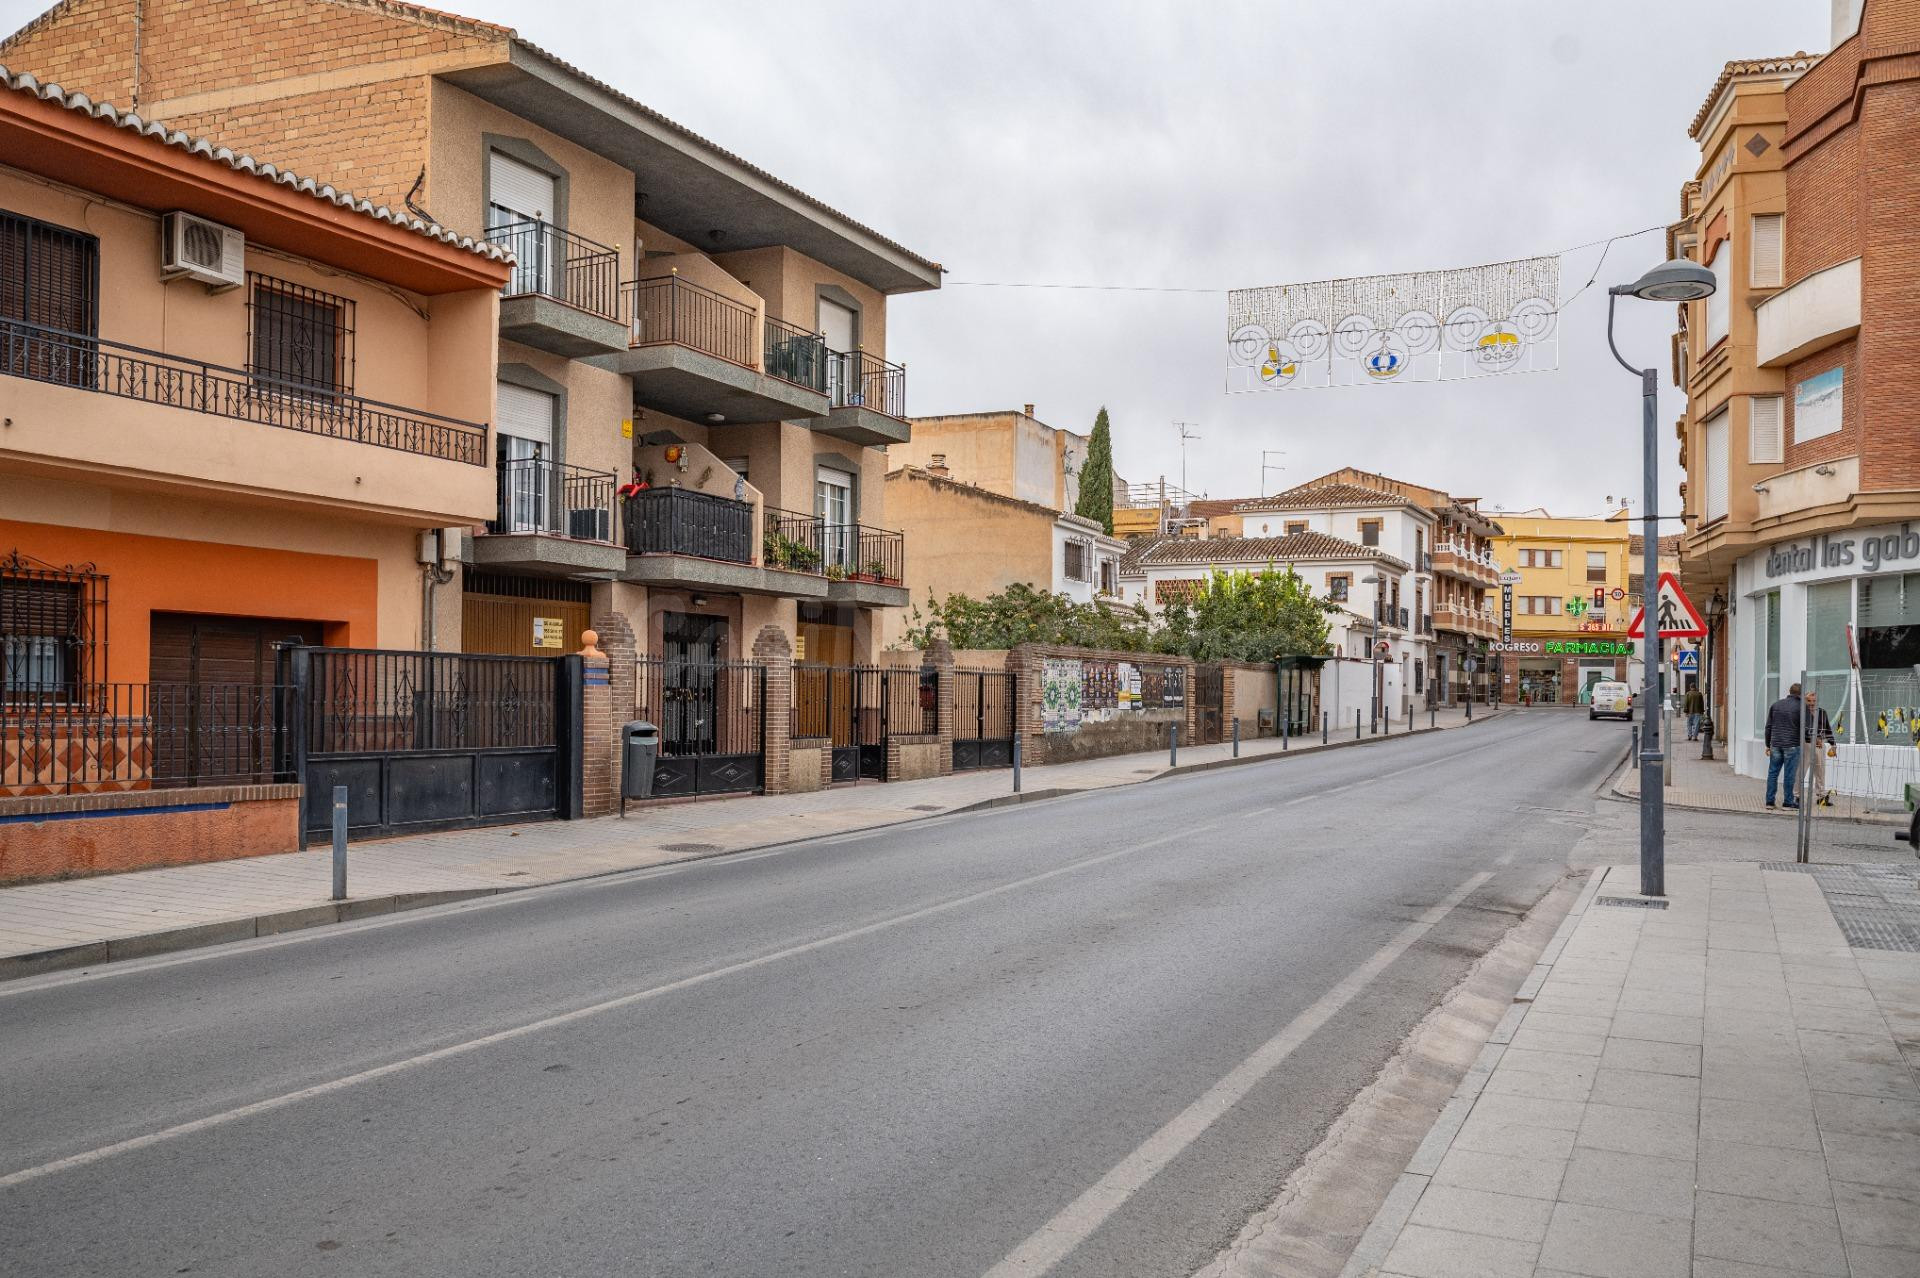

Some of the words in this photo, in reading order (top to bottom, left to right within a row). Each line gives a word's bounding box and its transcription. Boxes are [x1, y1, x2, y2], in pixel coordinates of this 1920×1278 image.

[1766, 536, 1817, 578] dental
[1820, 534, 1855, 568] las
[1503, 586, 1512, 643] MUEBLES
[1545, 641, 1626, 654] FARMACIA
